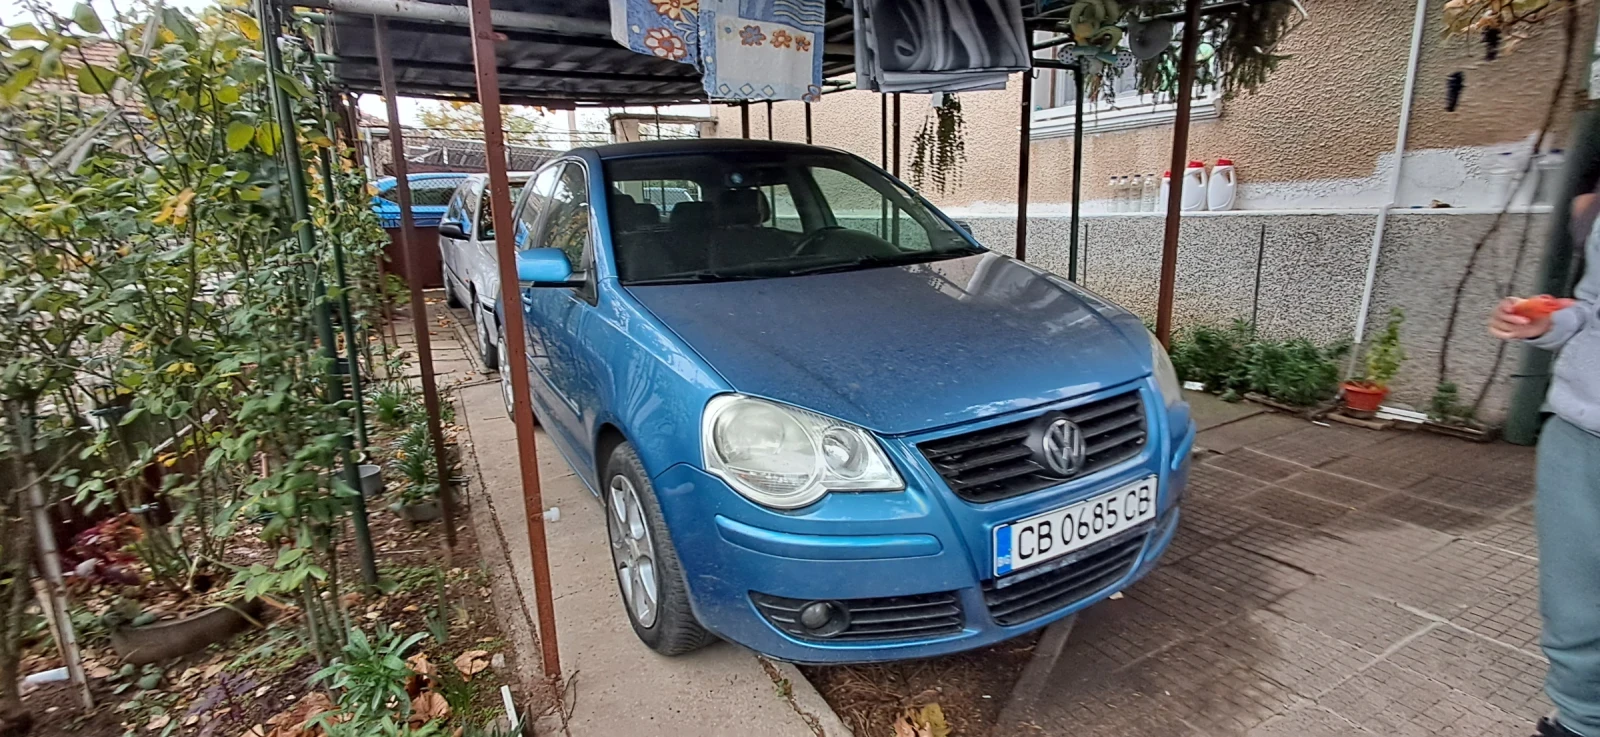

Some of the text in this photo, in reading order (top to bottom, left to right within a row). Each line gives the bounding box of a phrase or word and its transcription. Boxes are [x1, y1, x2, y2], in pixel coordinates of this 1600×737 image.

[1018, 485, 1151, 560] CB 0685 CB
